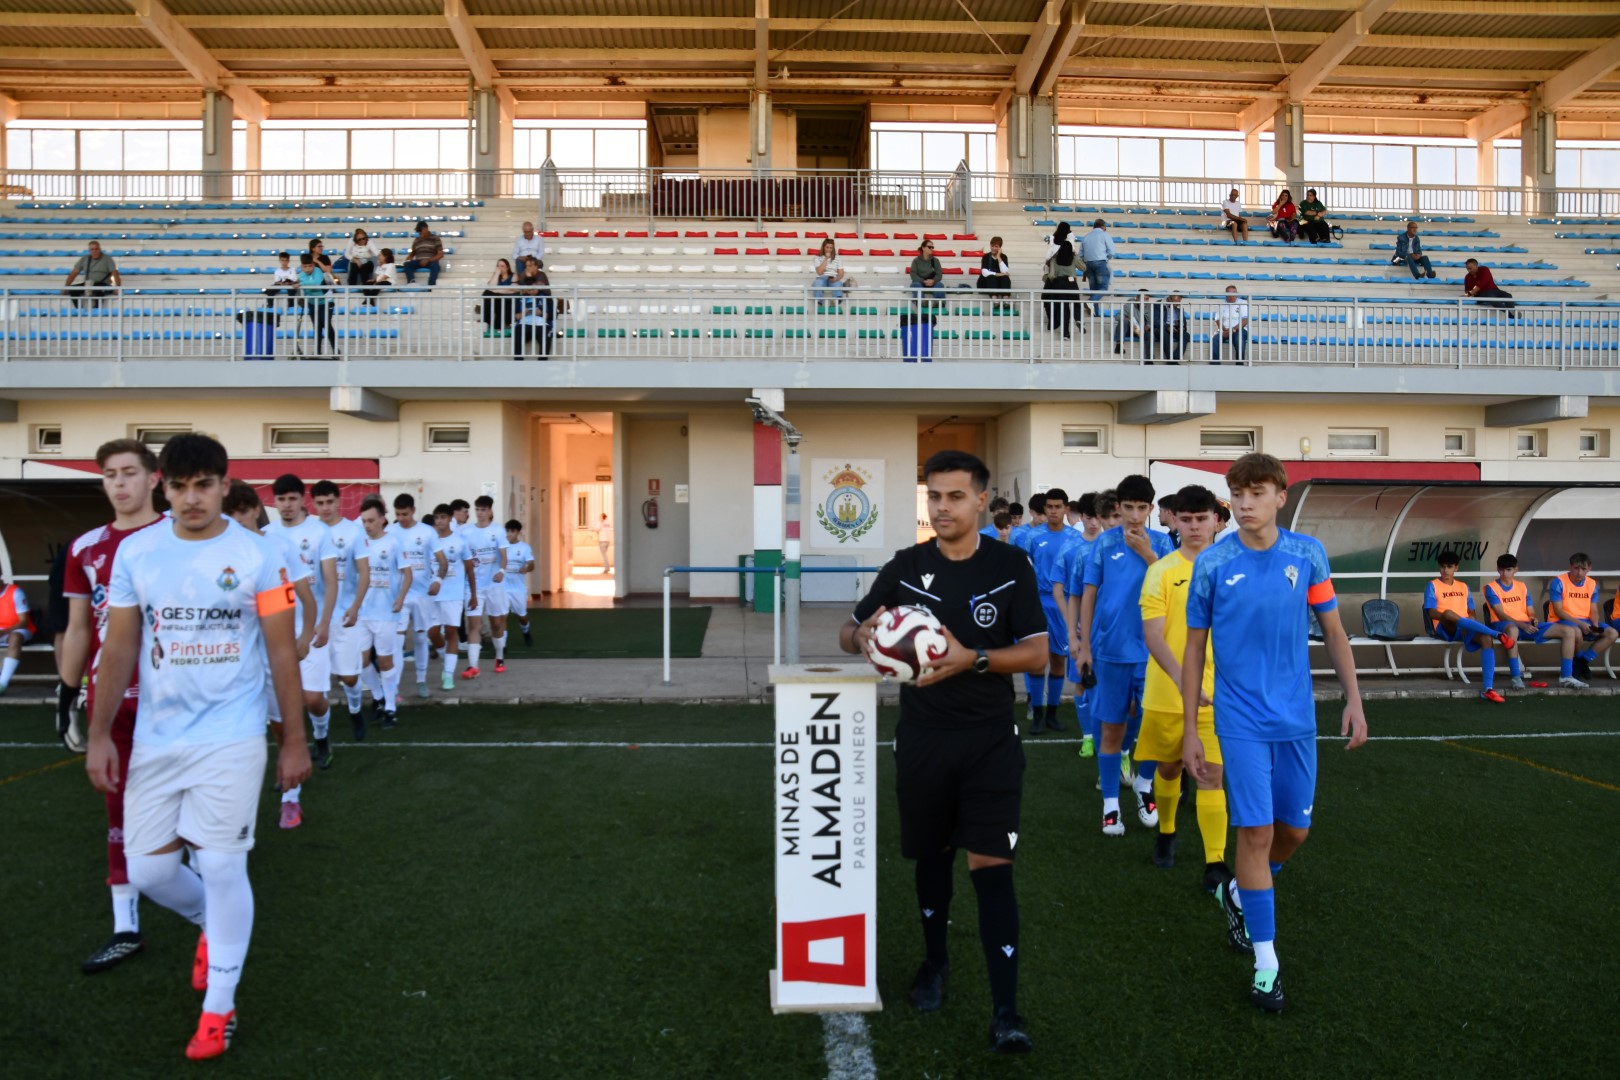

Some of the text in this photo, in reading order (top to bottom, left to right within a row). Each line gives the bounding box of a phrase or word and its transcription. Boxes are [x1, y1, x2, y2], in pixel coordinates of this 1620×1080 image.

[161, 607, 242, 620] GESTIONA
[170, 641, 240, 656] Pinturas
[170, 655, 240, 665] PEDRO CAMPOS
[781, 731, 800, 856] MINAS DE
[806, 692, 841, 888] ALMADÉN
[853, 710, 866, 869] PARQUE MINERO
